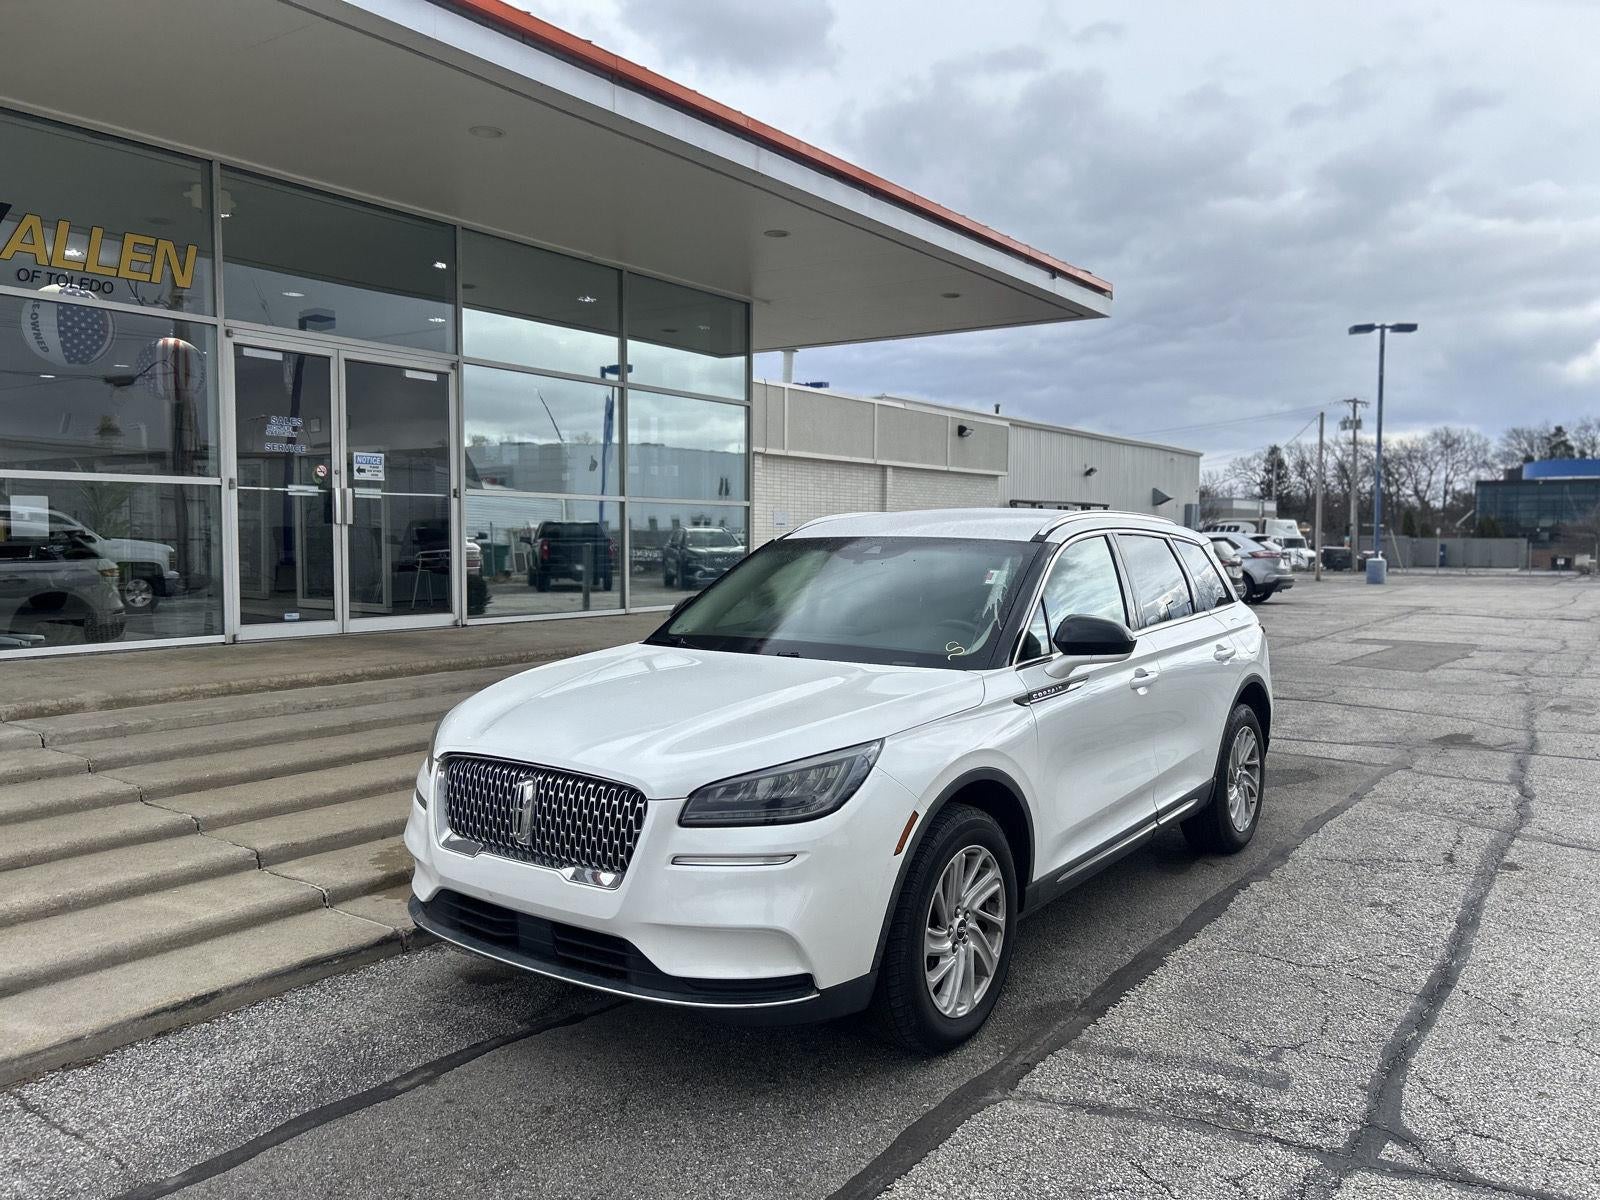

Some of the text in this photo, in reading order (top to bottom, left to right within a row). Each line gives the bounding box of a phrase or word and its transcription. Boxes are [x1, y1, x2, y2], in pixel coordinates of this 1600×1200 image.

[0, 212, 198, 289] ALLEN
[16, 267, 115, 295] OF TOLEDO
[270, 416, 303, 427] SALES
[265, 442, 306, 453] SERVICE
[356, 455, 382, 465] NOTICE
